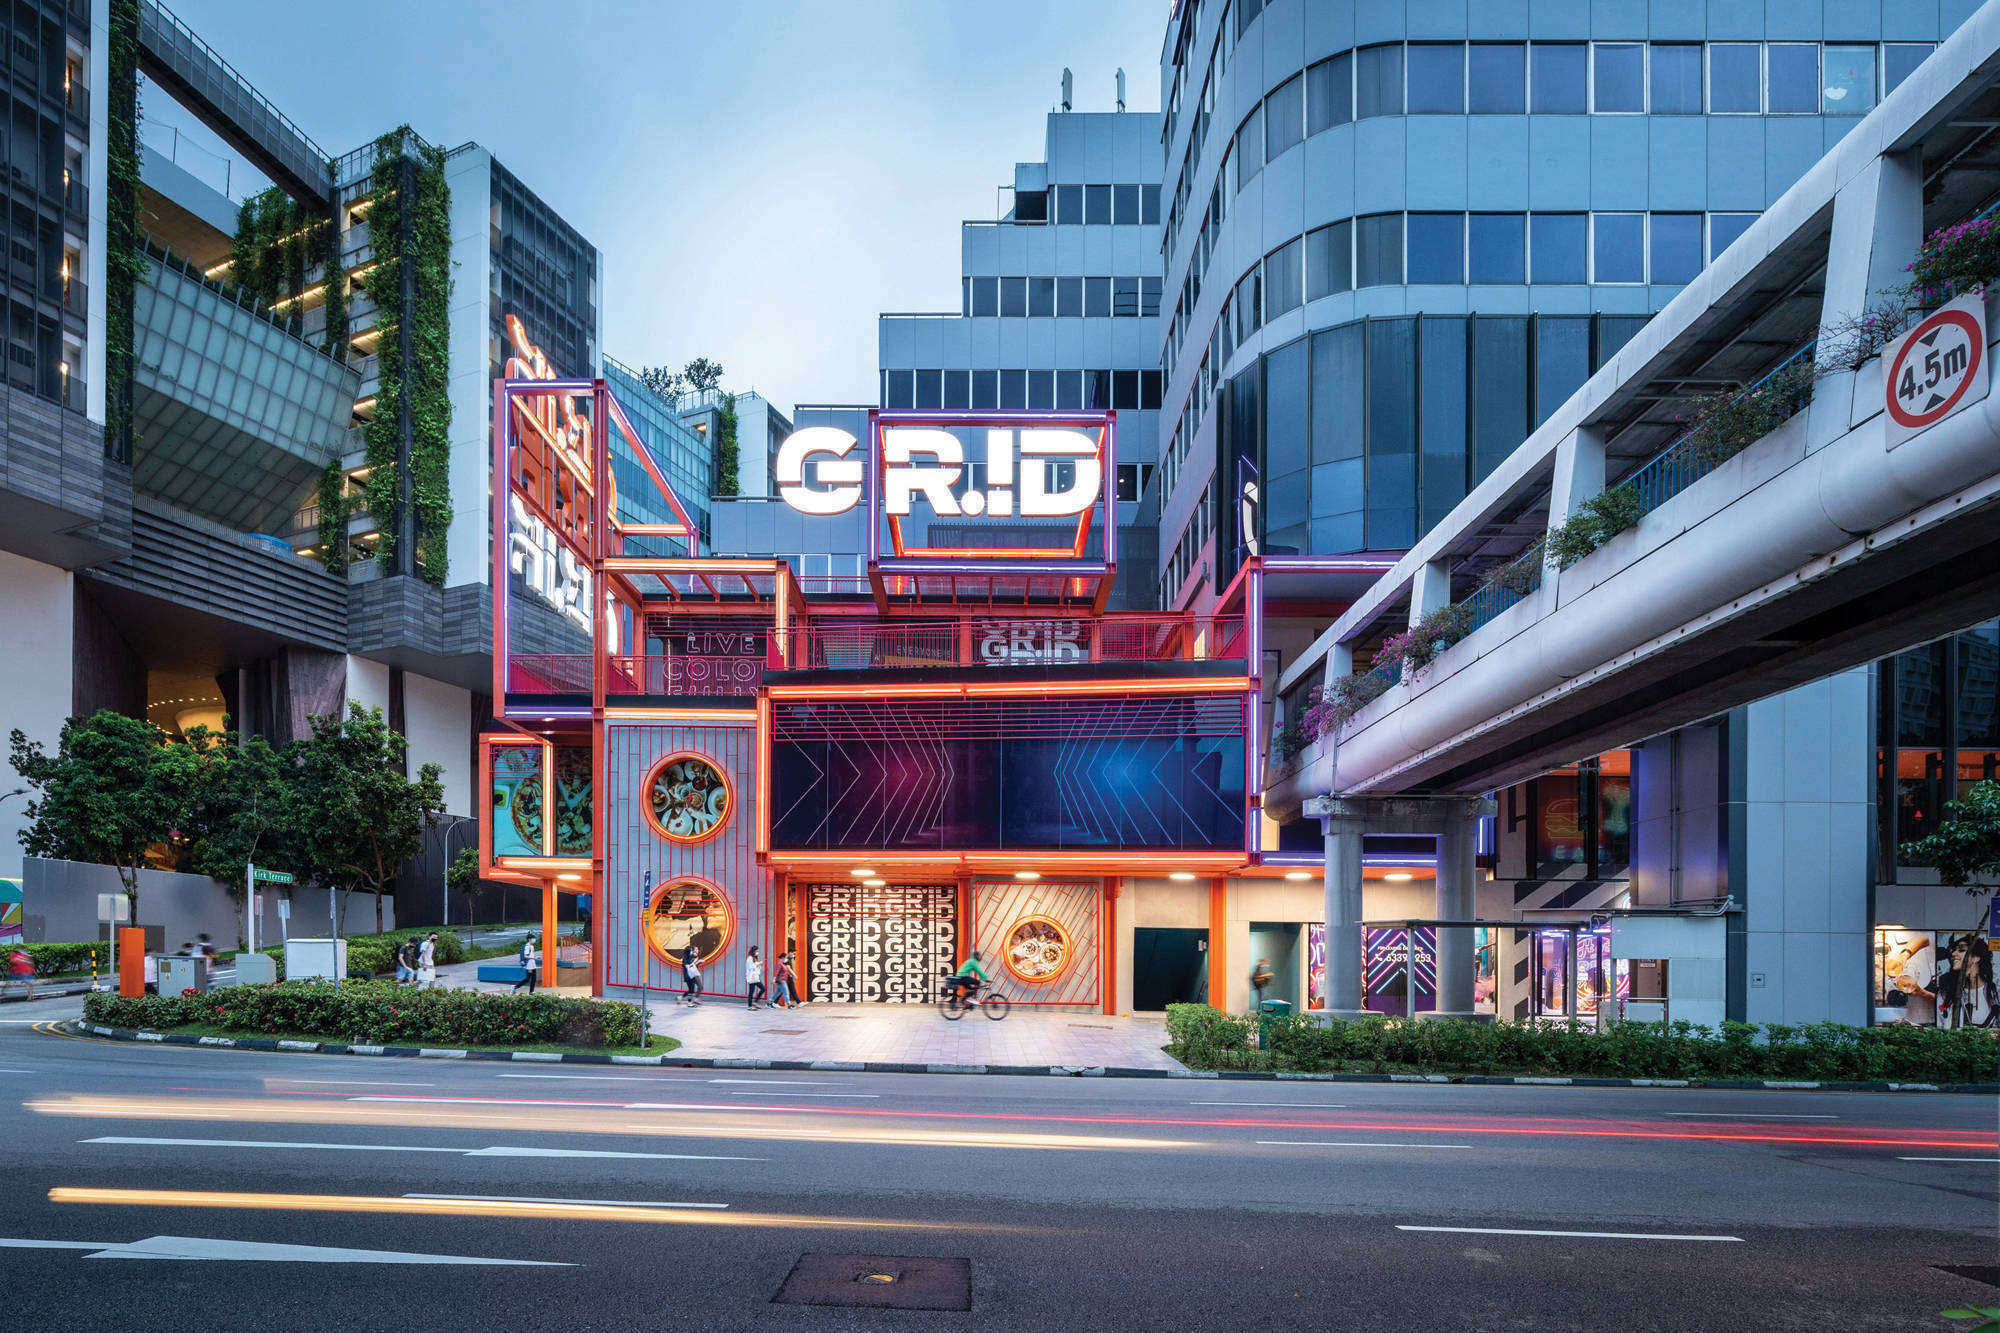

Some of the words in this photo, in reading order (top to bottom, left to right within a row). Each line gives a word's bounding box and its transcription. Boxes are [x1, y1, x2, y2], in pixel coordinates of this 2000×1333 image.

[1899, 343, 1967, 401] 4.5m
[686, 632, 755, 655] LIVE
[663, 657, 765, 682] COLO
[254, 870, 266, 879] Kirk
[269, 872, 290, 882] Terrace
